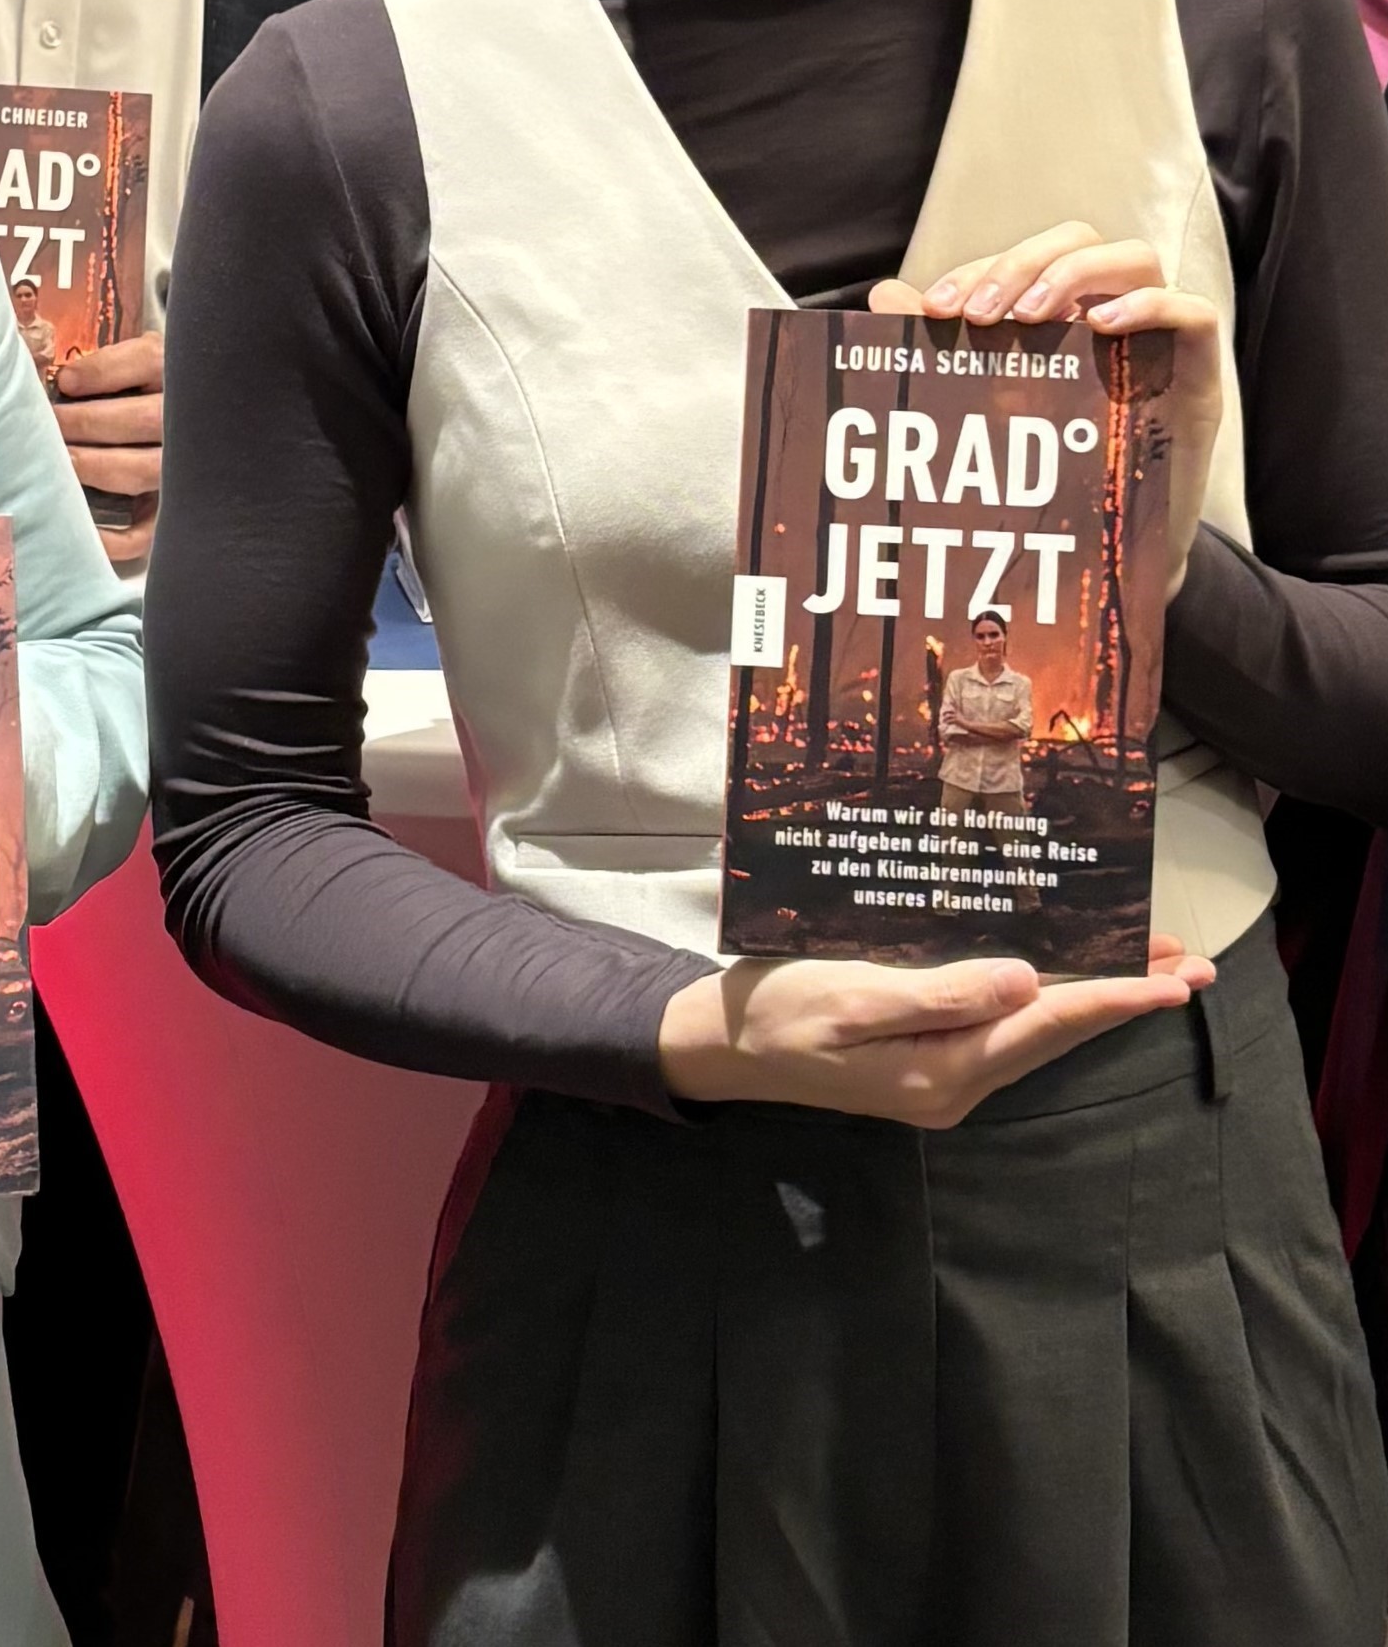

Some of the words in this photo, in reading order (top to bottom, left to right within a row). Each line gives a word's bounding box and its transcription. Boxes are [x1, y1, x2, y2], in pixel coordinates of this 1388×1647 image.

[835, 345, 926, 373] LOUISA
[936, 350, 1080, 380] SCHNEIDER
[825, 407, 1099, 507] GRAD°
[802, 523, 1076, 624] JETZT
[753, 588, 766, 653] KNESEBECK
[826, 801, 888, 823] Warum
[894, 805, 924, 825] wir
[929, 807, 958, 827] die
[964, 809, 1048, 837] Hoffnung
[775, 826, 821, 847] nicht
[827, 830, 912, 854] aufgeben
[918, 834, 979, 855] dürfen
[1002, 839, 1042, 859] eine
[1048, 841, 1098, 862] Reise
[811, 860, 832, 875] zu
[838, 857, 871, 877] den
[877, 859, 1058, 888] Klimabrennpunkten
[854, 890, 926, 908] unseres
[932, 889, 1013, 912] Planeten
